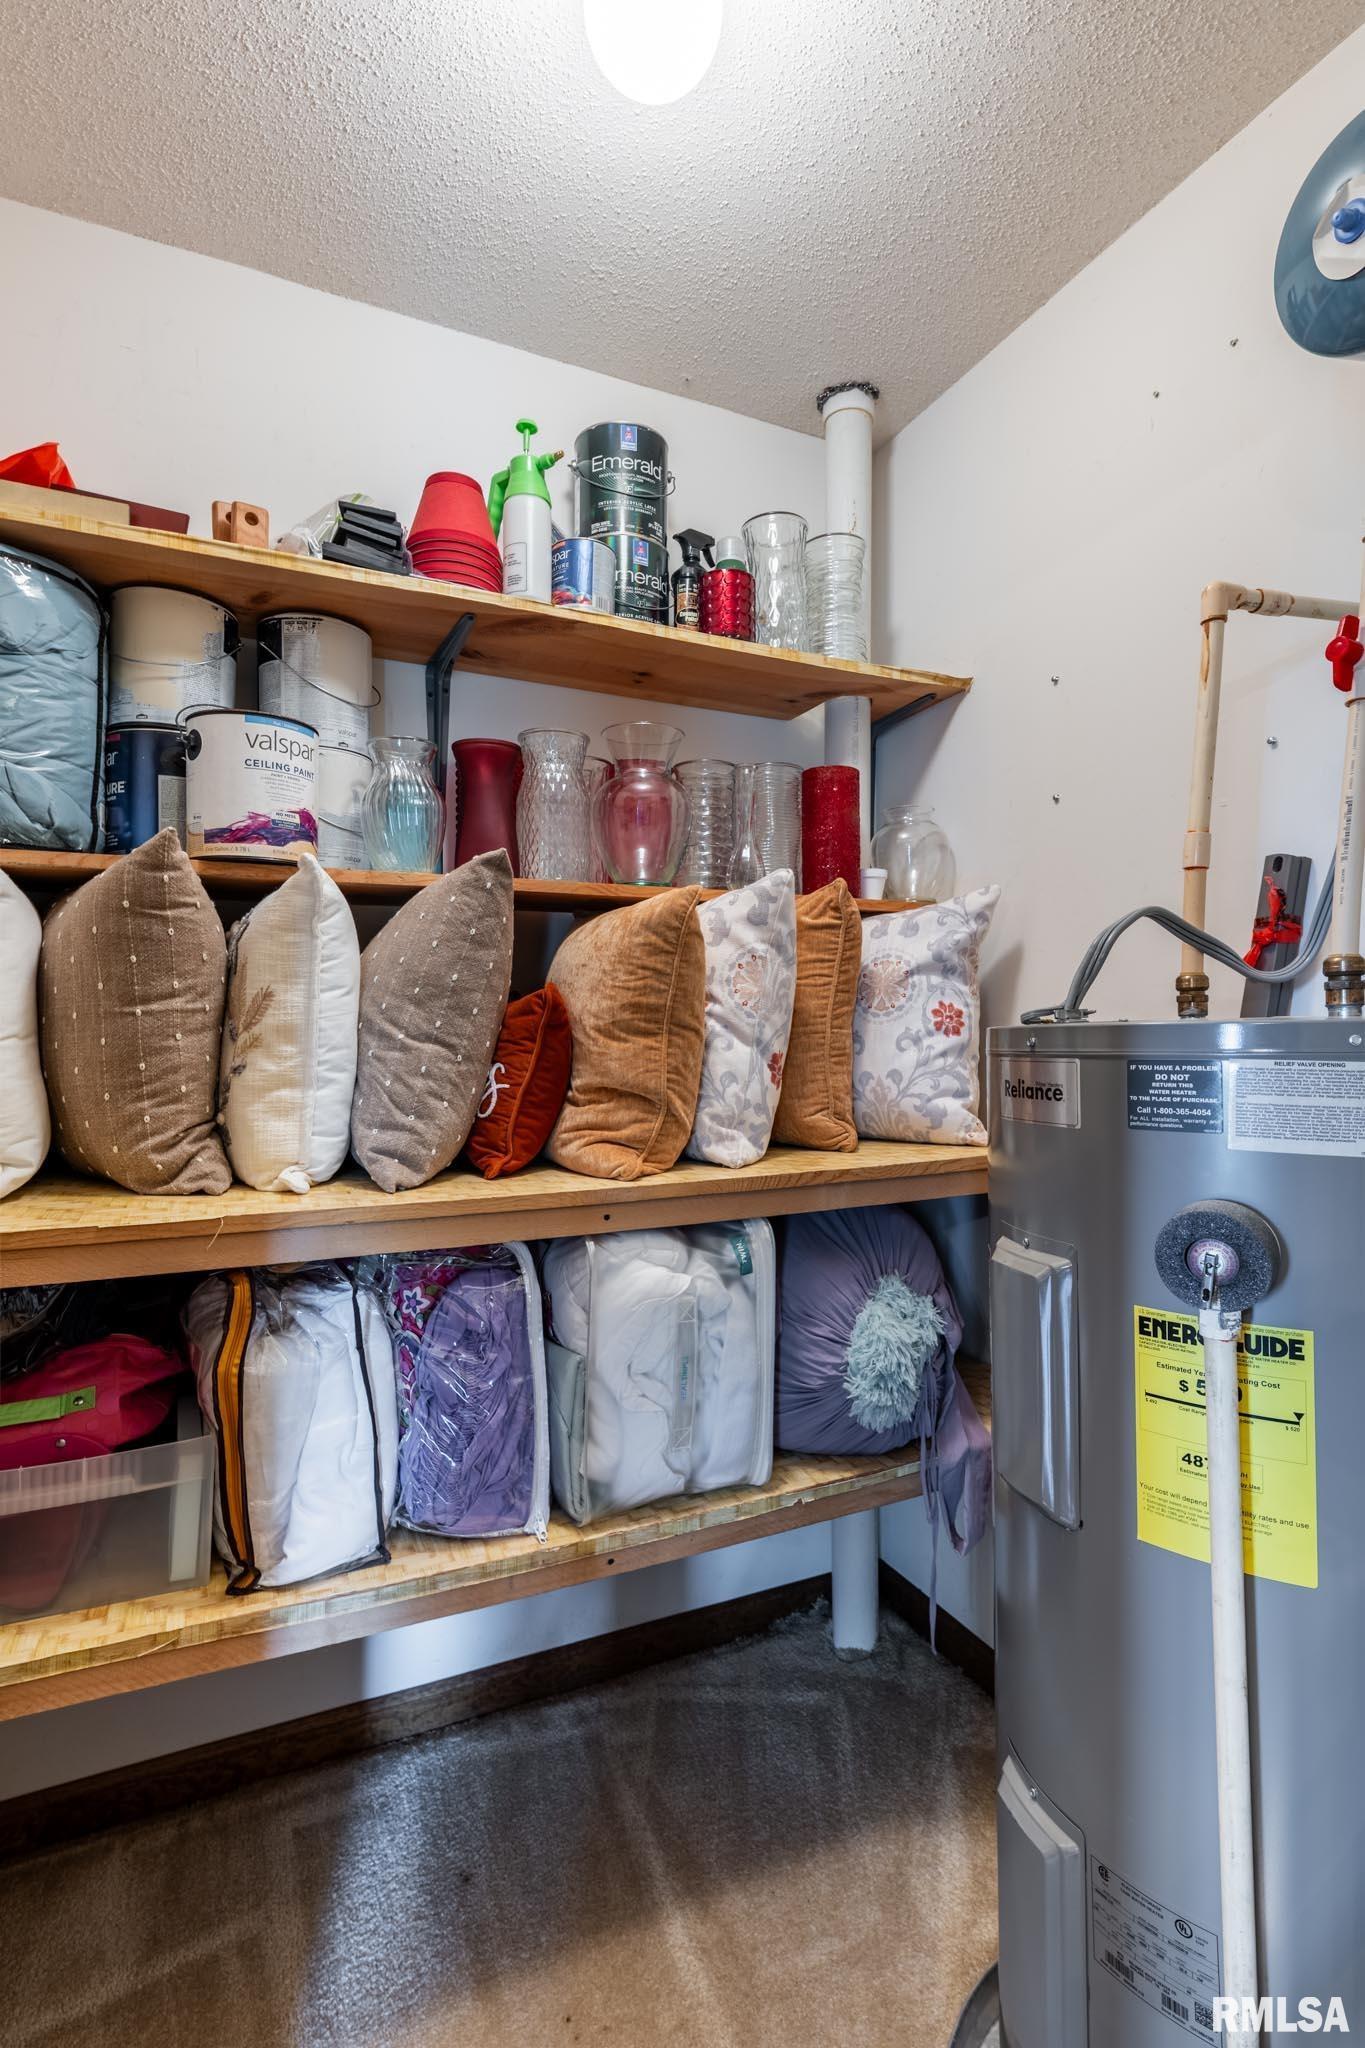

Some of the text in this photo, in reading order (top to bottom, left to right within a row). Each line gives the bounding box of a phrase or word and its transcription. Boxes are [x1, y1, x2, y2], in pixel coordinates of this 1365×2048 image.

[592, 455, 662, 480] Emerald
[615, 569, 667, 595] merald
[245, 730, 314, 761] valspar
[244, 758, 314, 780] CEILING PAINT
[1004, 1078, 1064, 1101] Reliance
[1153, 1107, 1211, 1116] 1-800-365-4054
[1156, 1361, 1192, 1376] Estimated
[1261, 1379, 1281, 1389] Cost
[1179, 1379, 1189, 1393] $
[1139, 1481, 1154, 1491] Your
[1155, 1487, 1169, 1497] cost
[1170, 1491, 1181, 1500] will
[1182, 1493, 1208, 1507] depend
[1258, 1514, 1278, 1524] rates
[1279, 1518, 1294, 1526] and
[1296, 1521, 1310, 1530] use
